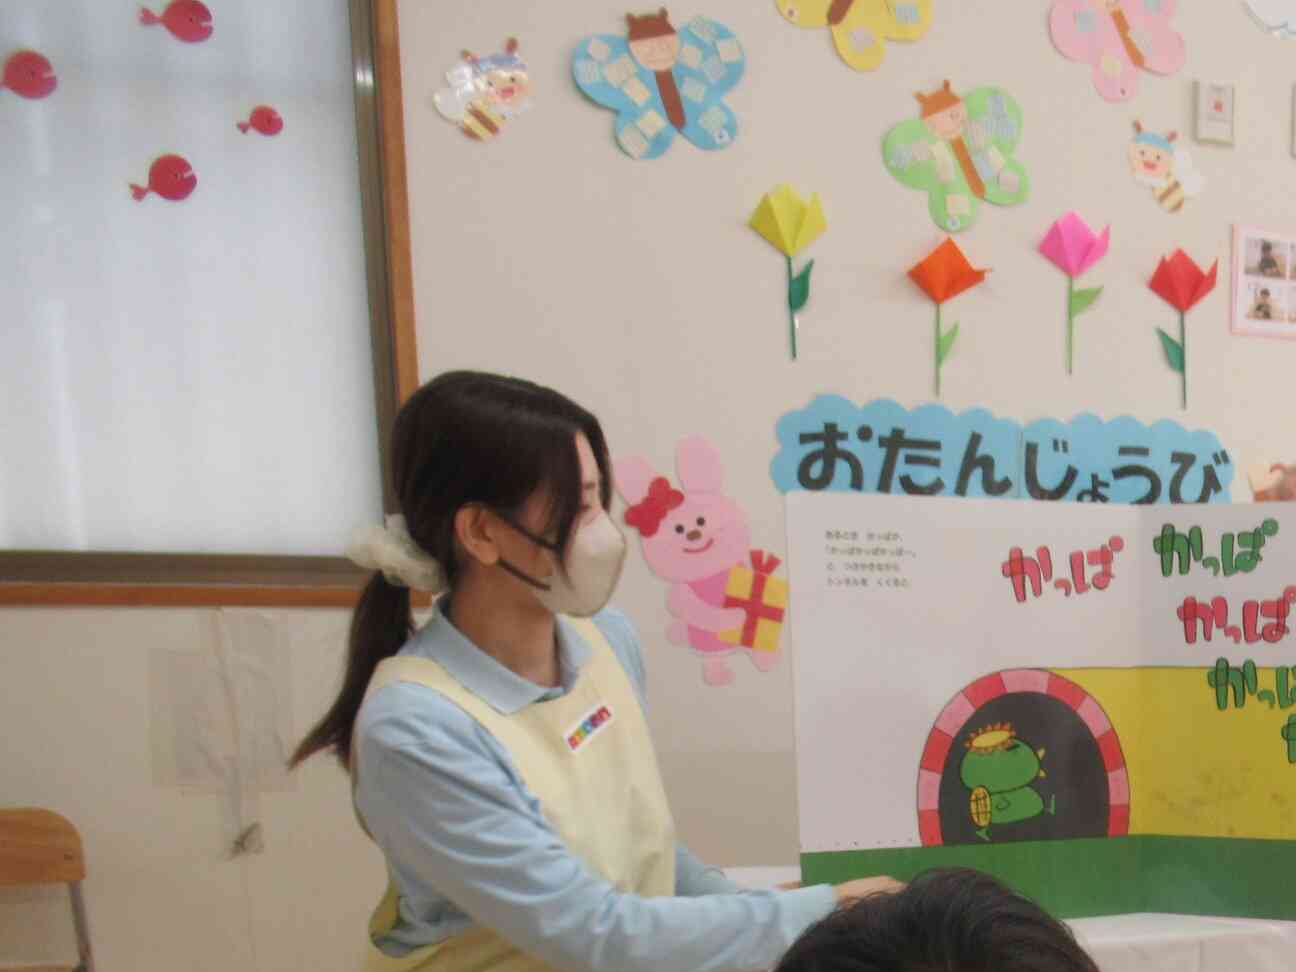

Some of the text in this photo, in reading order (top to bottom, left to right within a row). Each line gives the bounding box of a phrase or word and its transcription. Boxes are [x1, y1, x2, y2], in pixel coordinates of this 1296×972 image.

[797, 422, 1230, 505] おたんじょうび
[1002, 535, 1125, 603] かっぱ
[1153, 517, 1280, 577] かっぱ
